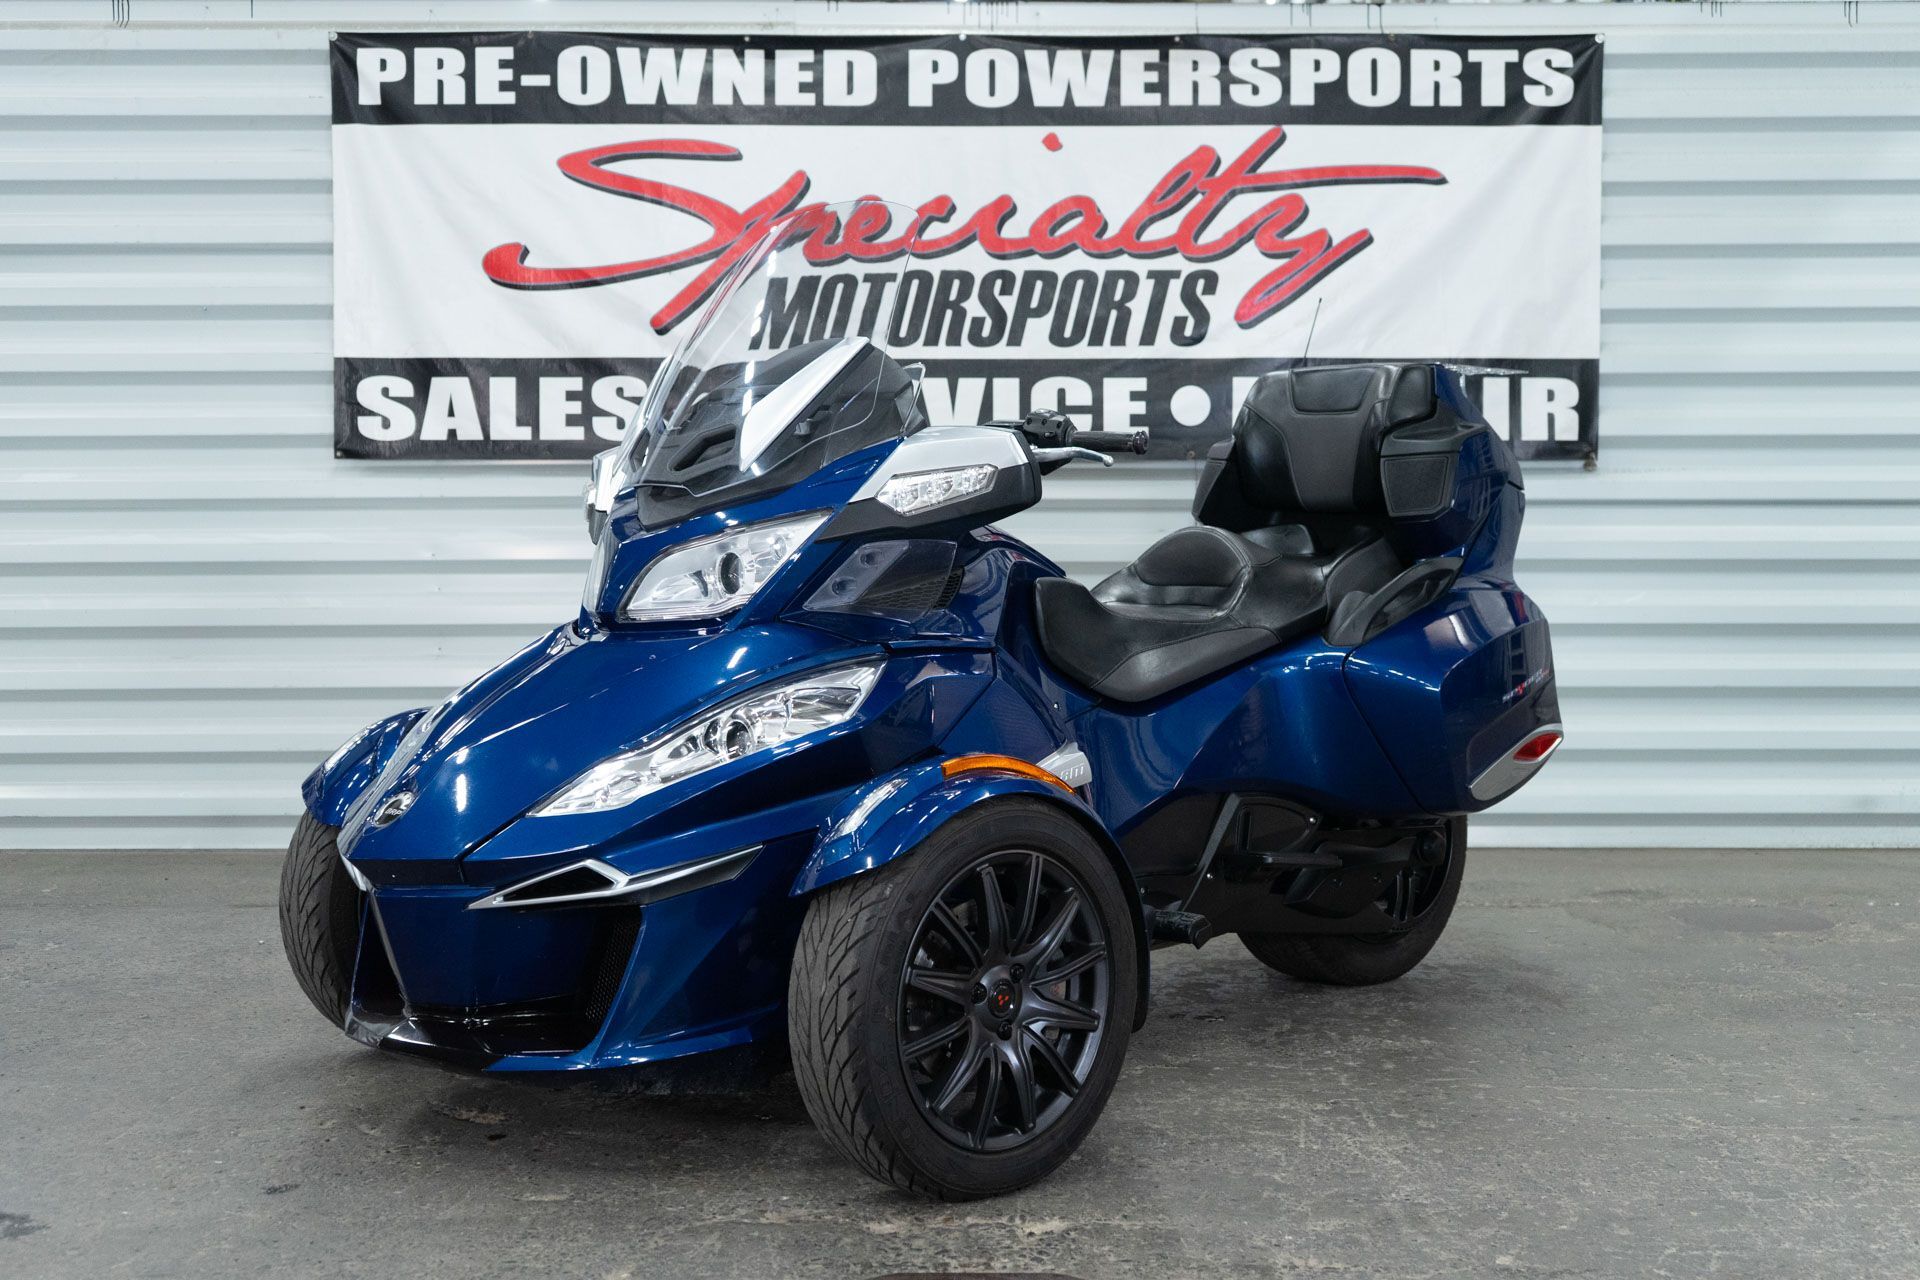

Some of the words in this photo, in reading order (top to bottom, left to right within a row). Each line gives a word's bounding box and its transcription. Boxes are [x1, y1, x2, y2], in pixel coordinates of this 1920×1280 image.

[355, 45, 878, 107] PRE-OWNED
[907, 47, 1575, 108] POWERSPORTS
[481, 125, 1449, 336] Specialty
[747, 268, 1220, 351] MOTORSPORTS
[355, 375, 645, 442] SALES
